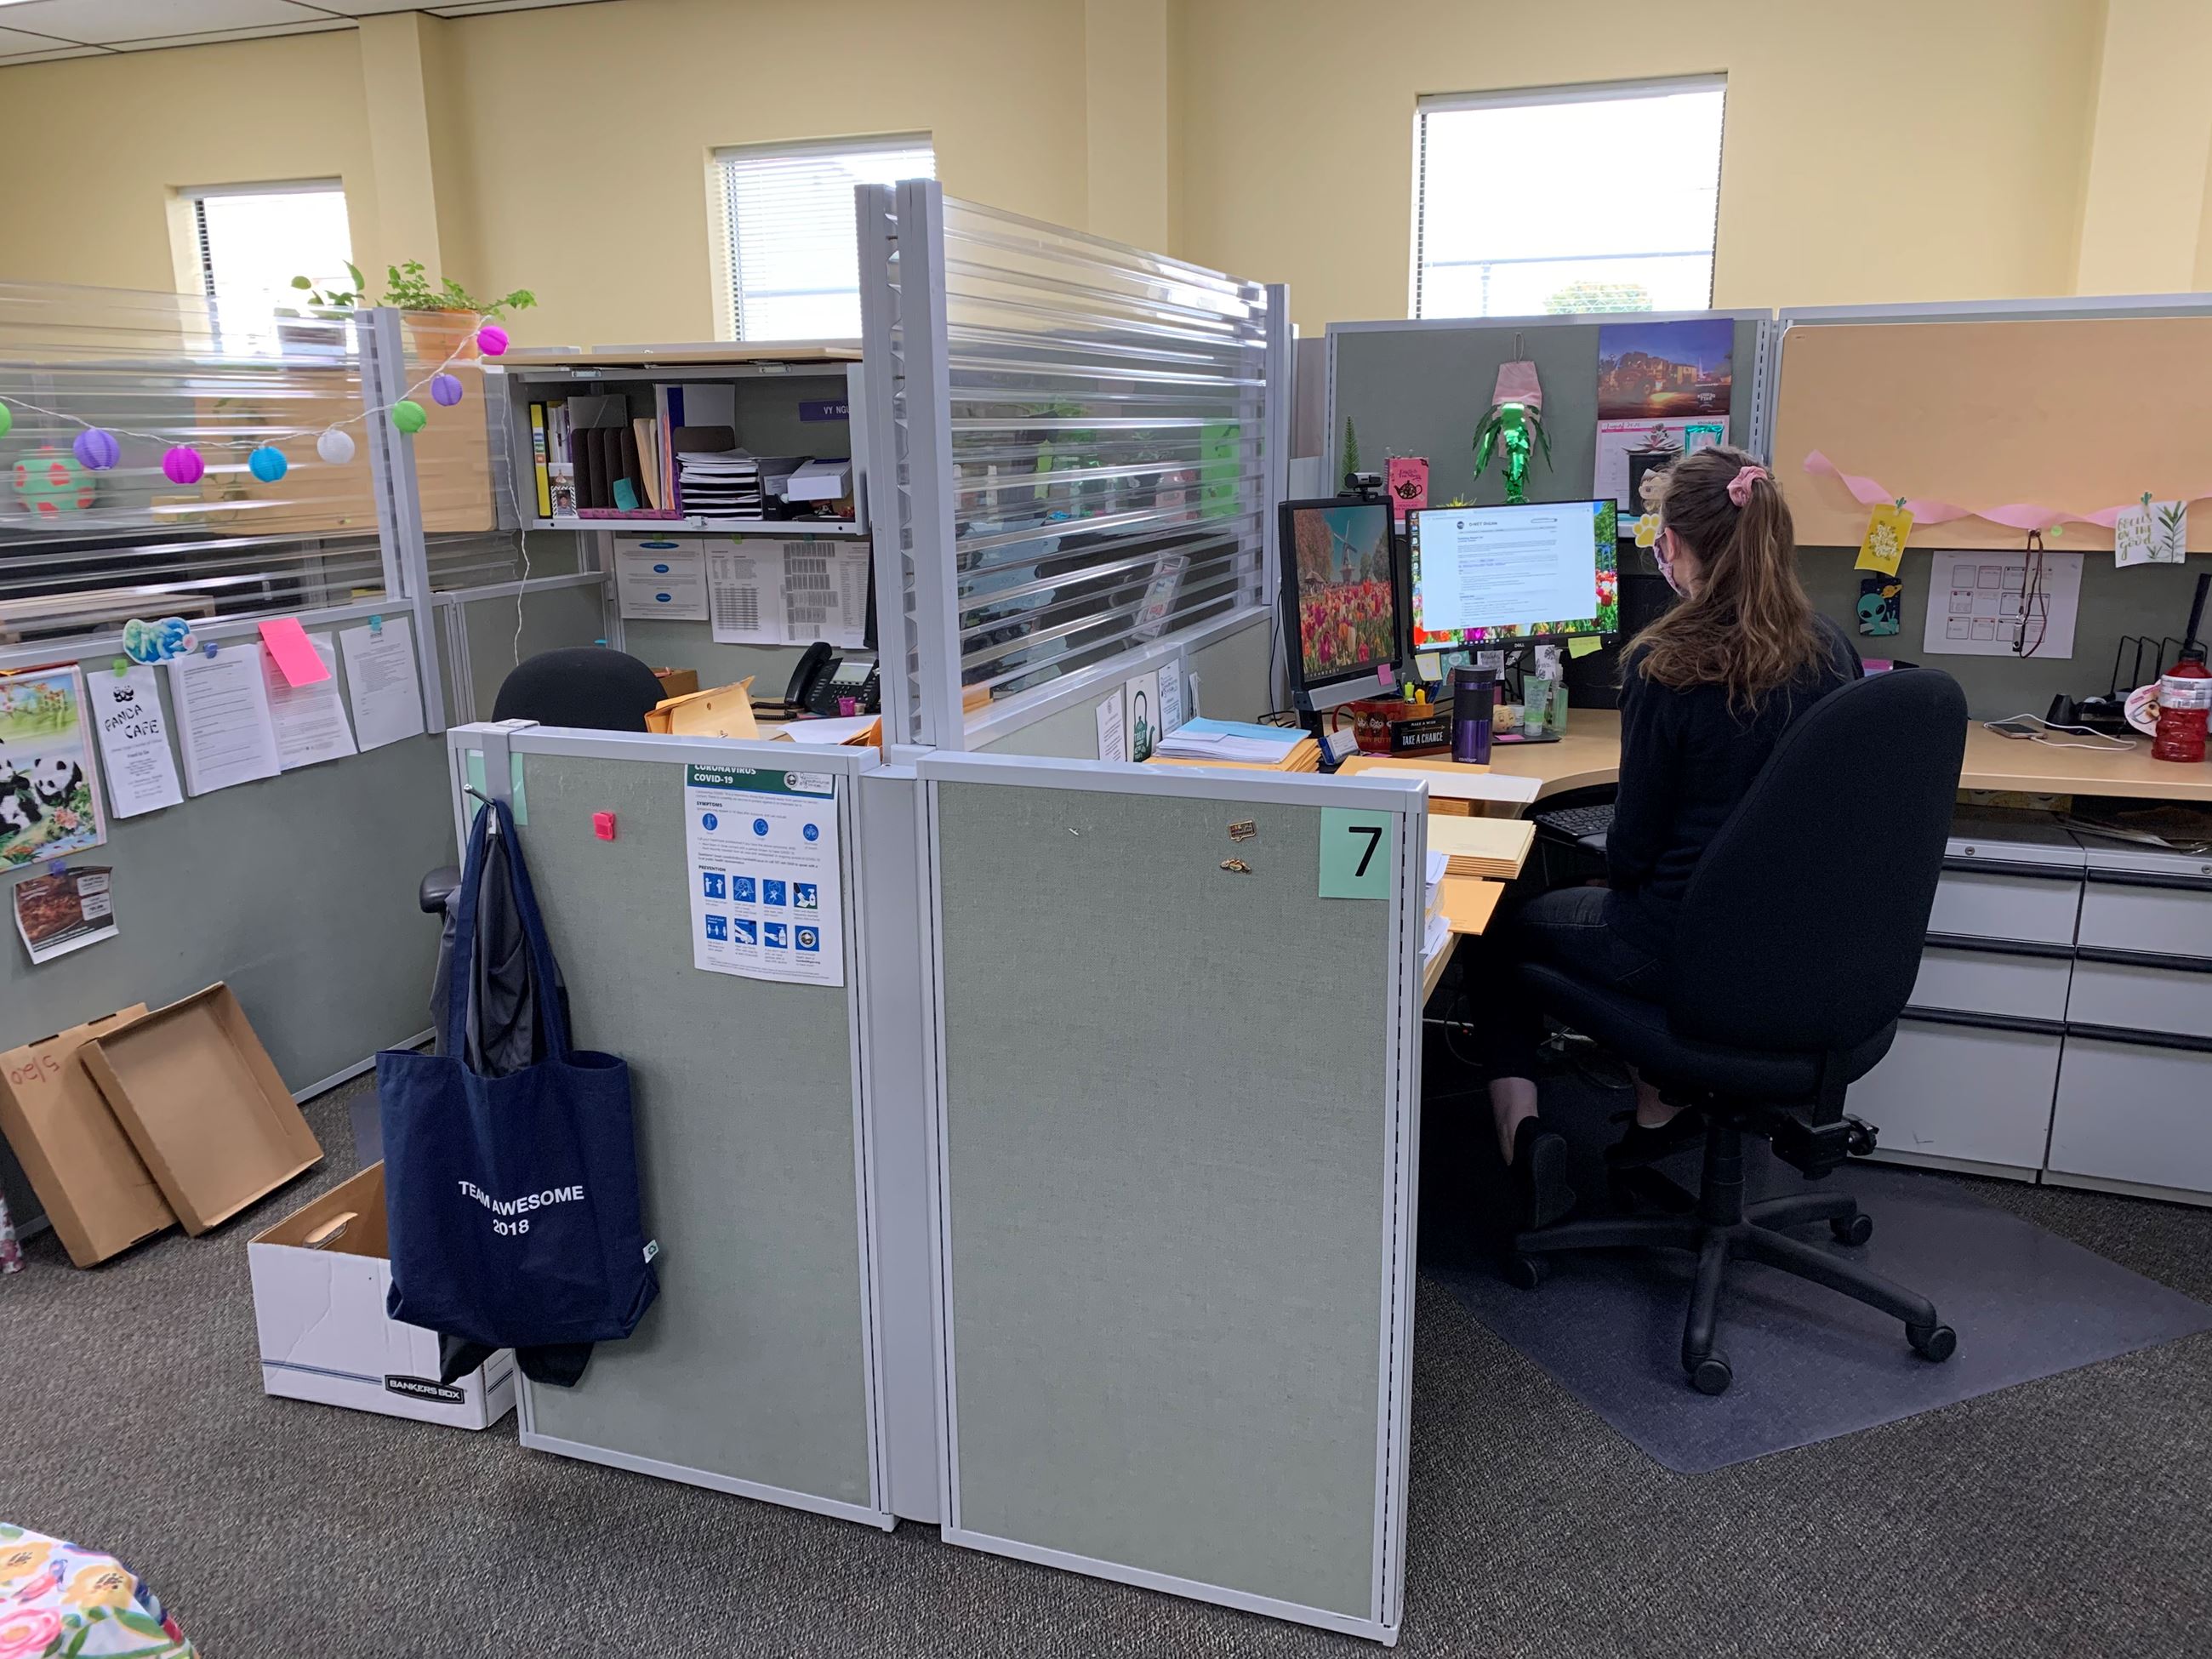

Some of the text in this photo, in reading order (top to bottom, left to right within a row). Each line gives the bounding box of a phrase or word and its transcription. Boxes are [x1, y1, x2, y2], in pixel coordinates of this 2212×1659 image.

[824, 407, 833, 415] VY
[104, 704, 143, 732] PANDA
[124, 720, 160, 739] CAFE
[1402, 732, 1443, 745] TAKE A CHANCE
[693, 773, 733, 784] COVID-19
[1348, 827, 1382, 876] 7
[458, 1181, 585, 1217] TEAM AWESOME
[493, 1219, 530, 1235] 2018
[389, 1380, 460, 1400] BANKERS BOX
